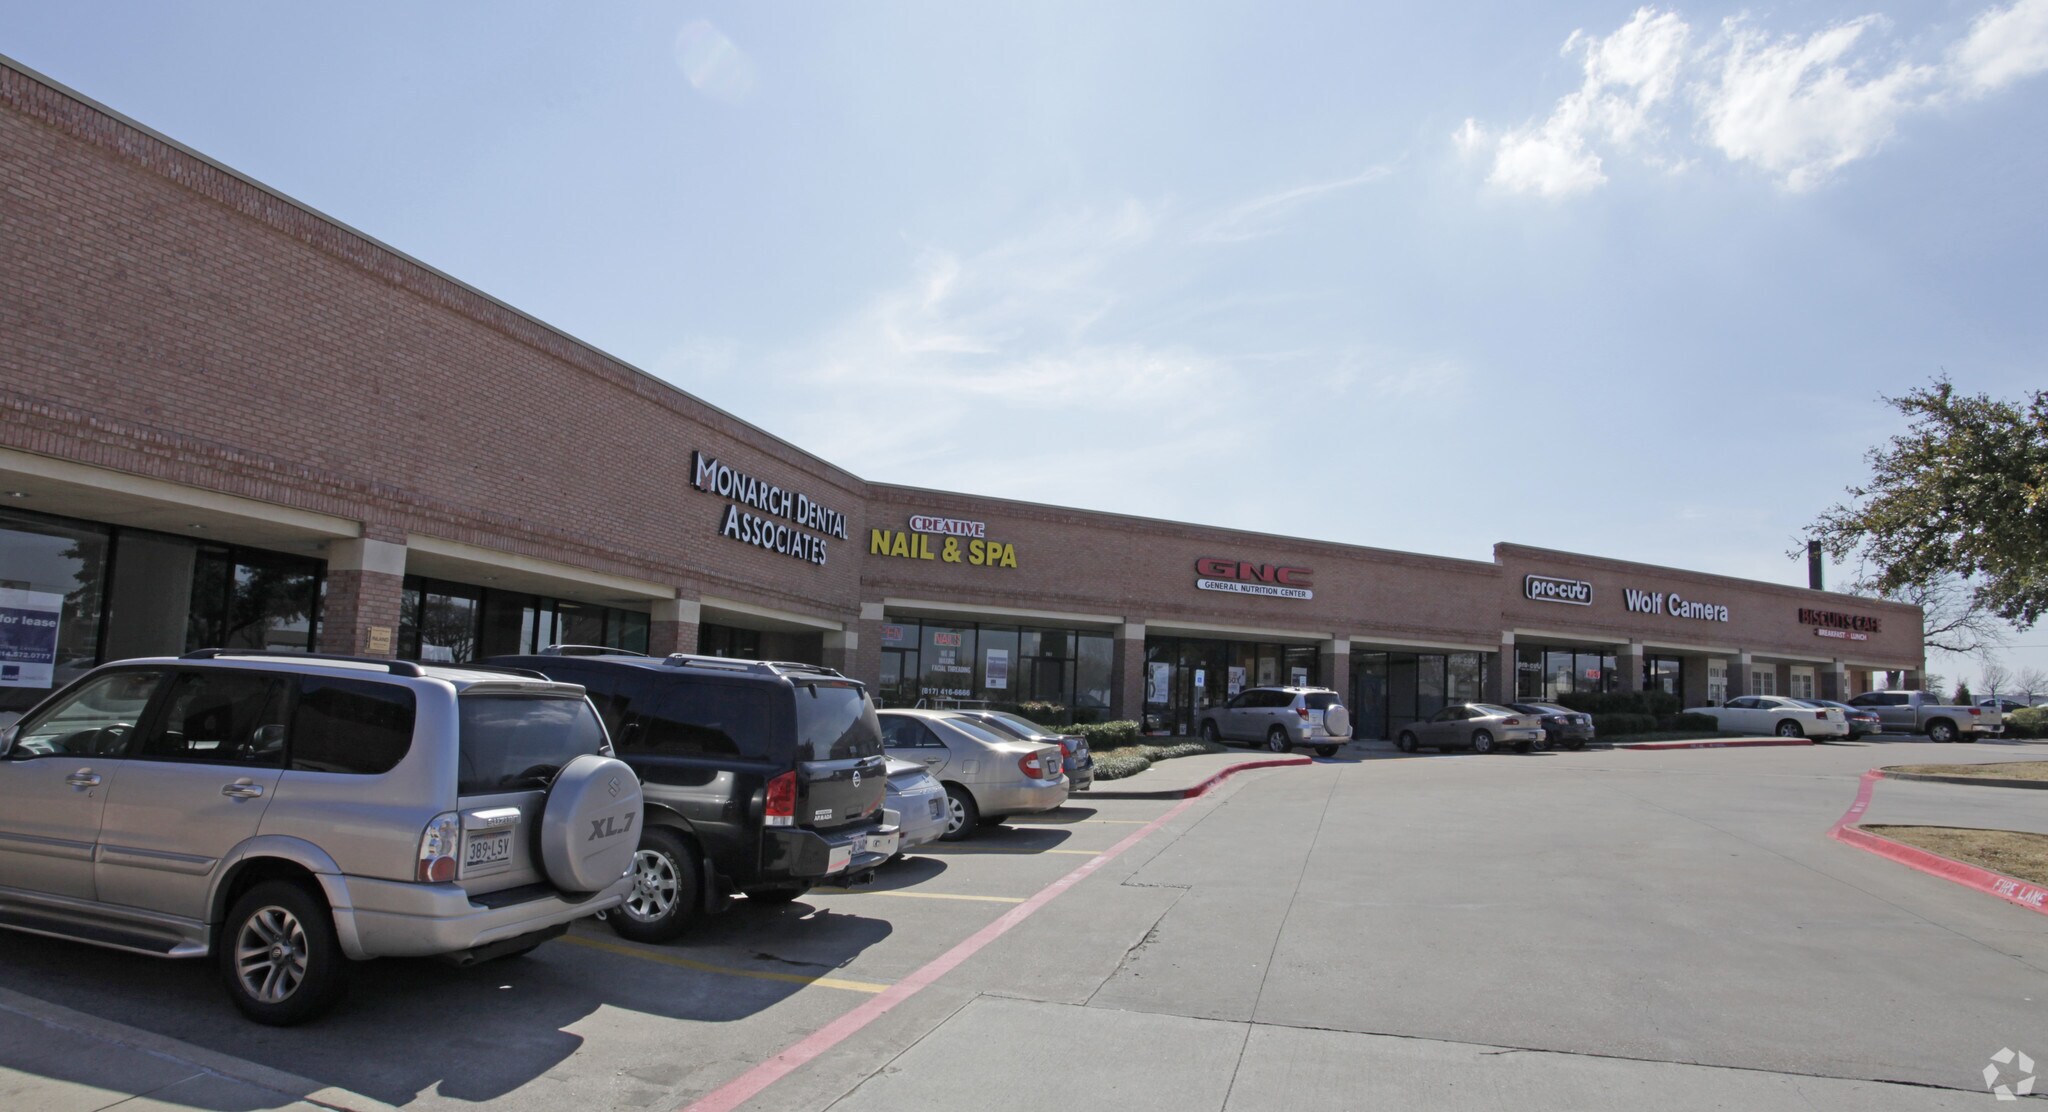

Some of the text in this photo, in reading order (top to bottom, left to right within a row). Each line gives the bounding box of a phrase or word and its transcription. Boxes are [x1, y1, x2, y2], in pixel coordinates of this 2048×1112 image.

[695, 451, 849, 540] MONARCH DENTAL
[723, 504, 827, 565] ASSOCIATES
[911, 517, 984, 536] CREATIVE
[871, 529, 1017, 568] NAIL & SPA
[1197, 558, 1314, 587] GNC
[1204, 581, 1306, 598] GENERAL NUTRITION CENTER
[1625, 588, 1728, 622] Wolf Camera
[22, 616, 56, 628] lease
[1818, 628, 1867, 641] BREAKFAST LUNCH
[921, 687, 939, 696] (817)
[1992, 879, 2047, 907] FIRE LANE
